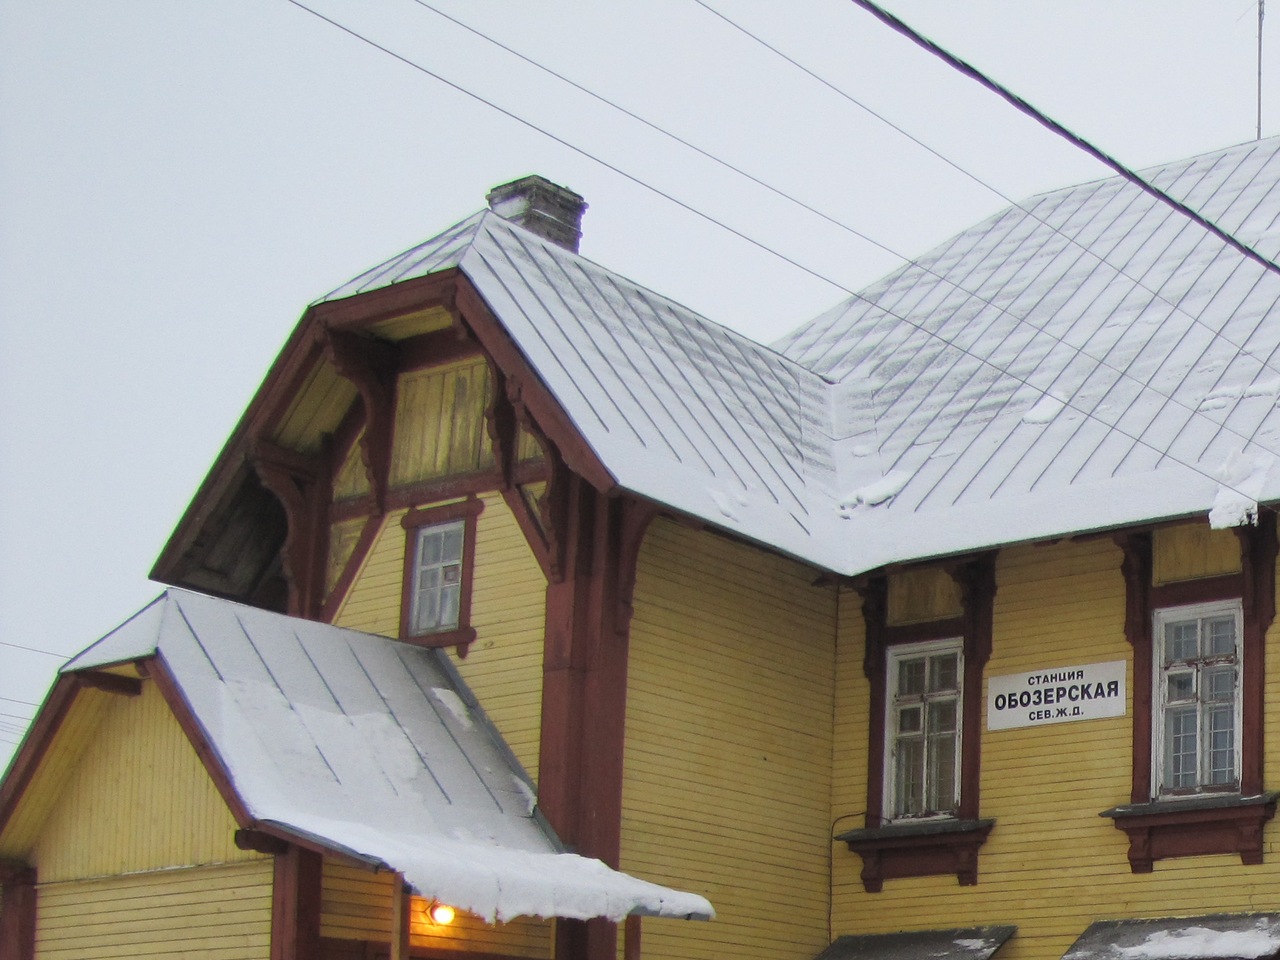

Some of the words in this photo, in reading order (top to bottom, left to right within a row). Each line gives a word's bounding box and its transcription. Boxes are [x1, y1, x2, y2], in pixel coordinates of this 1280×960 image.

[1028, 670, 1084, 685] СТАНЦИЯ
[994, 681, 1119, 710] ОБОЗЕРСКАЯ
[1029, 706, 1084, 721] СЕВ.Ж.Д.
